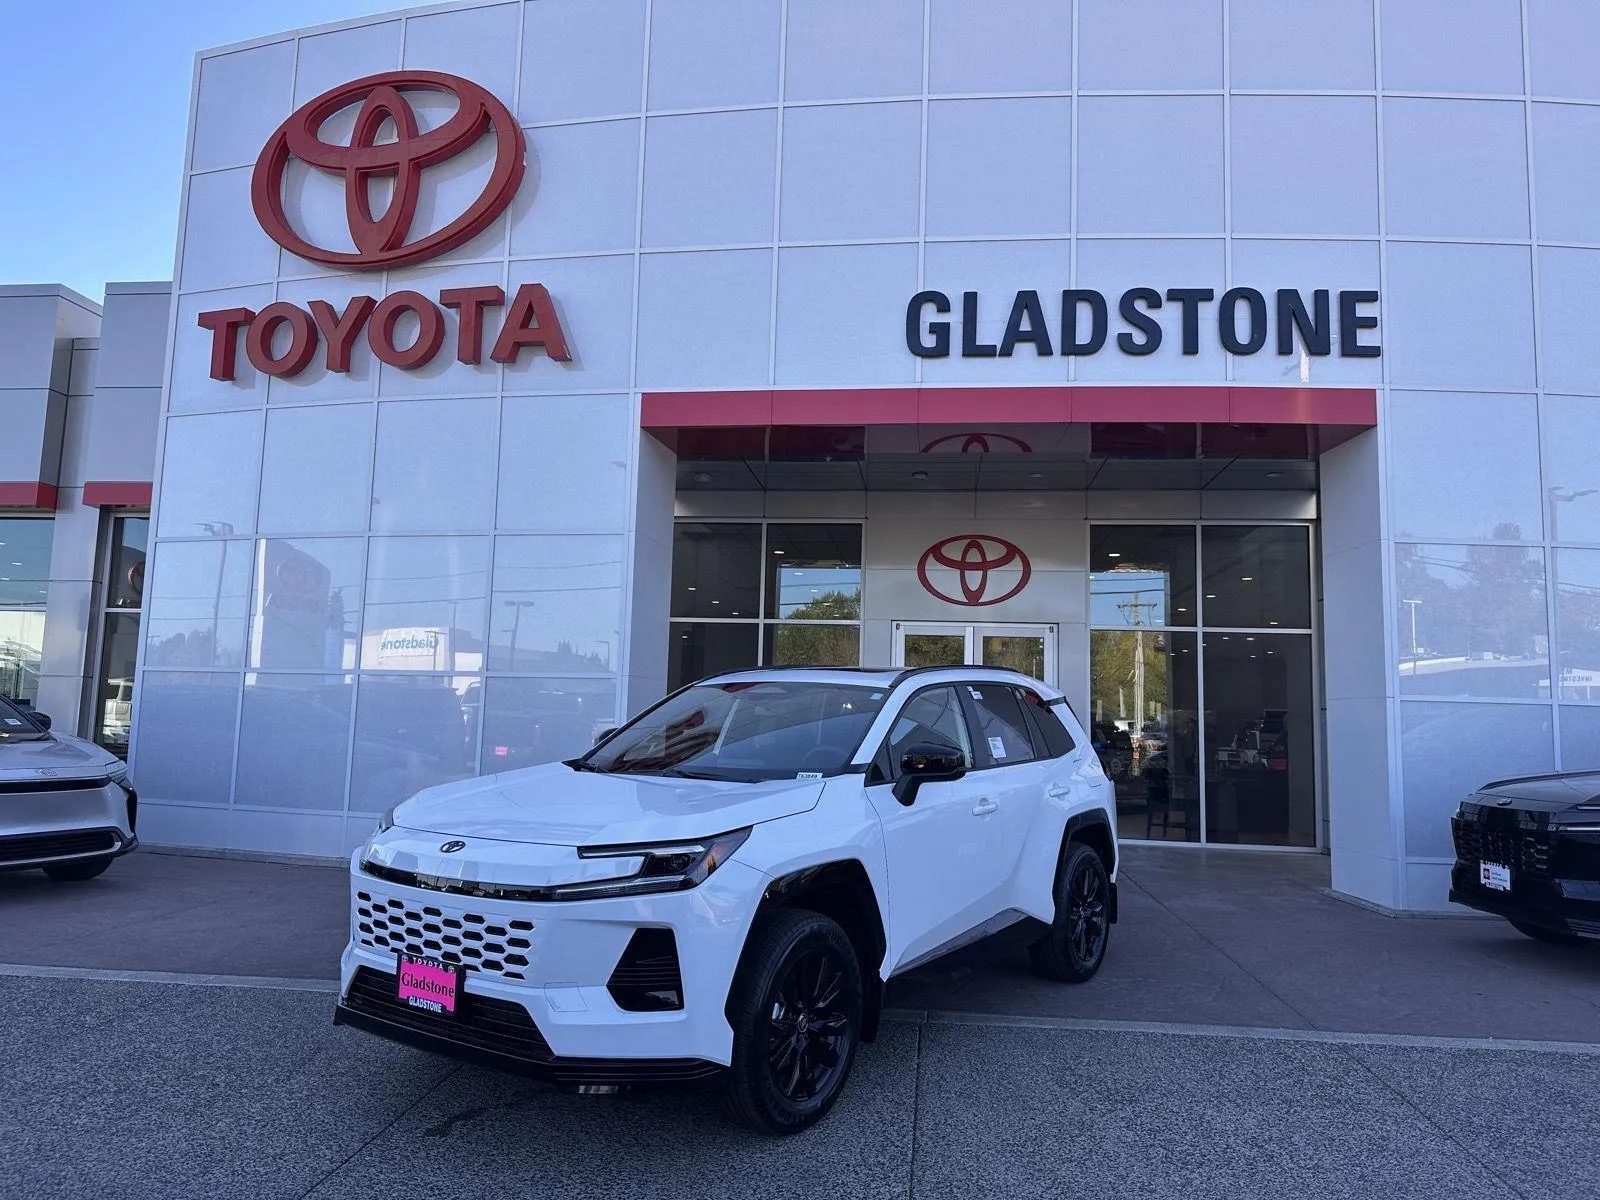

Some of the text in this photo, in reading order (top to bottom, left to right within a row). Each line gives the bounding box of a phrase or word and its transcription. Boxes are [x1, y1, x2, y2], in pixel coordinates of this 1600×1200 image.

[197, 283, 573, 382] TOYOTA
[905, 287, 1382, 358] GLADSTONE
[412, 957, 444, 970] TOYOTA
[401, 972, 455, 998] Gladstone
[408, 996, 442, 1013] GLADSTONE
